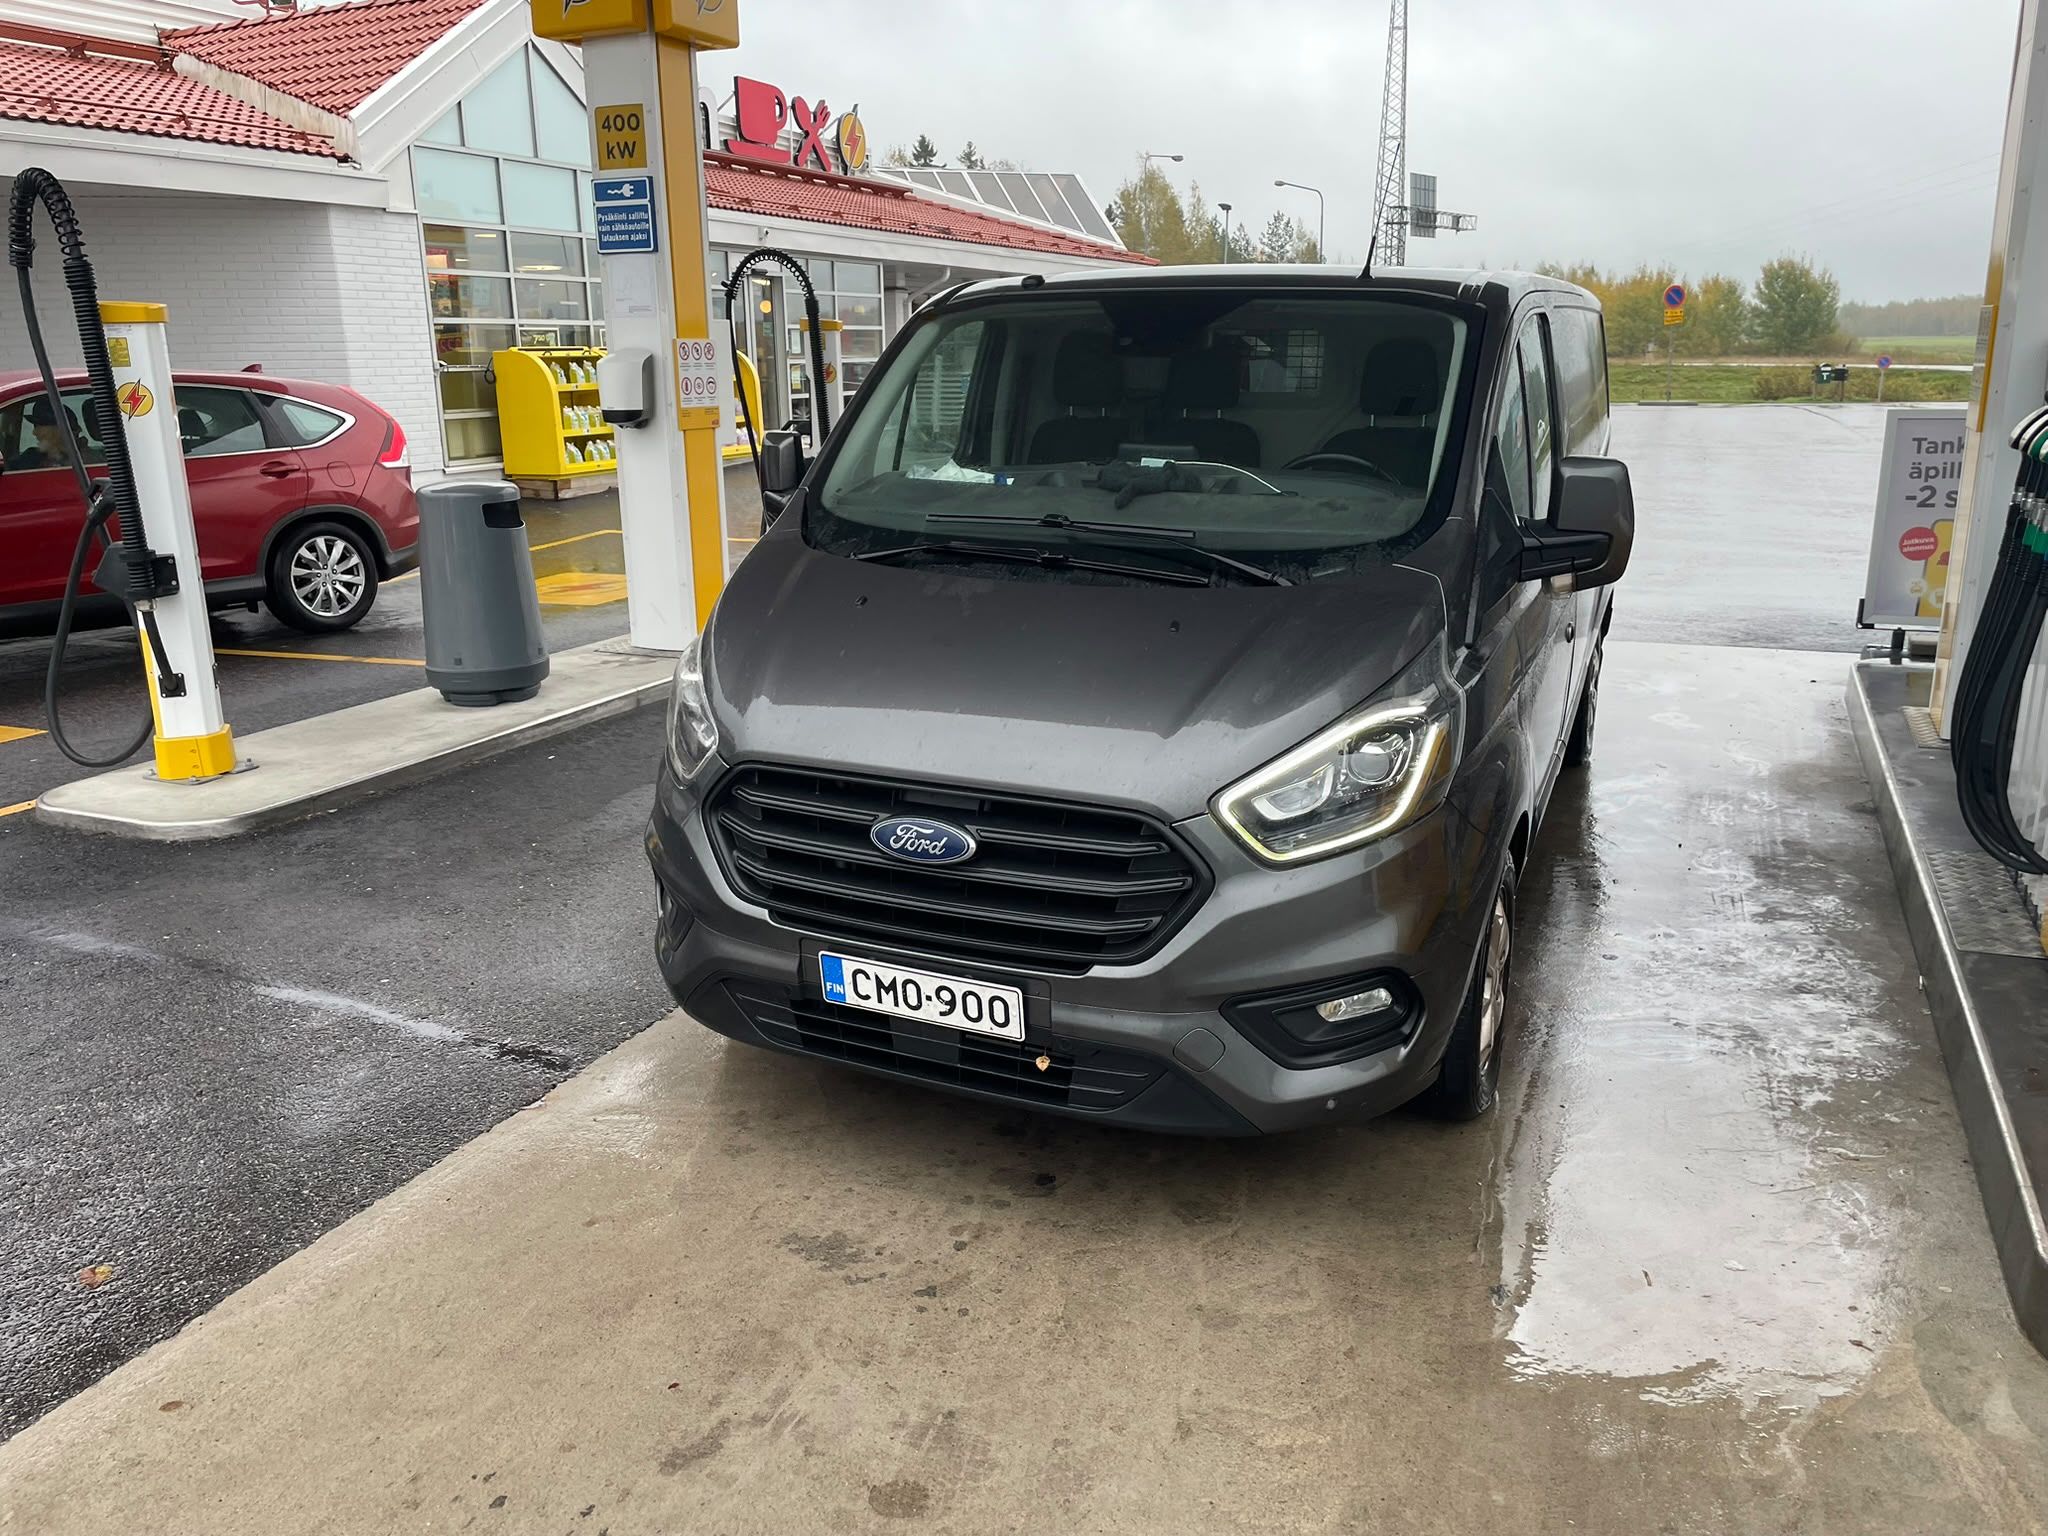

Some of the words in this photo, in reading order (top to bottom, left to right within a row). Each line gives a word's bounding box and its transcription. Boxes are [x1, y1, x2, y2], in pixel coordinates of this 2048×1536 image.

[602, 113, 640, 132] 400
[606, 141, 636, 160] kW
[597, 212, 627, 222] Pysäköinti
[628, 211, 649, 220] sallittu
[598, 223, 610, 231] vain
[611, 222, 649, 231] sähköautoille
[601, 233, 629, 241] latauksen
[630, 232, 648, 241] ajaksi
[1905, 485, 1937, 508] -2
[889, 824, 946, 856] Ford
[826, 981, 845, 994] FIN
[851, 968, 1010, 1028] CMO-900
